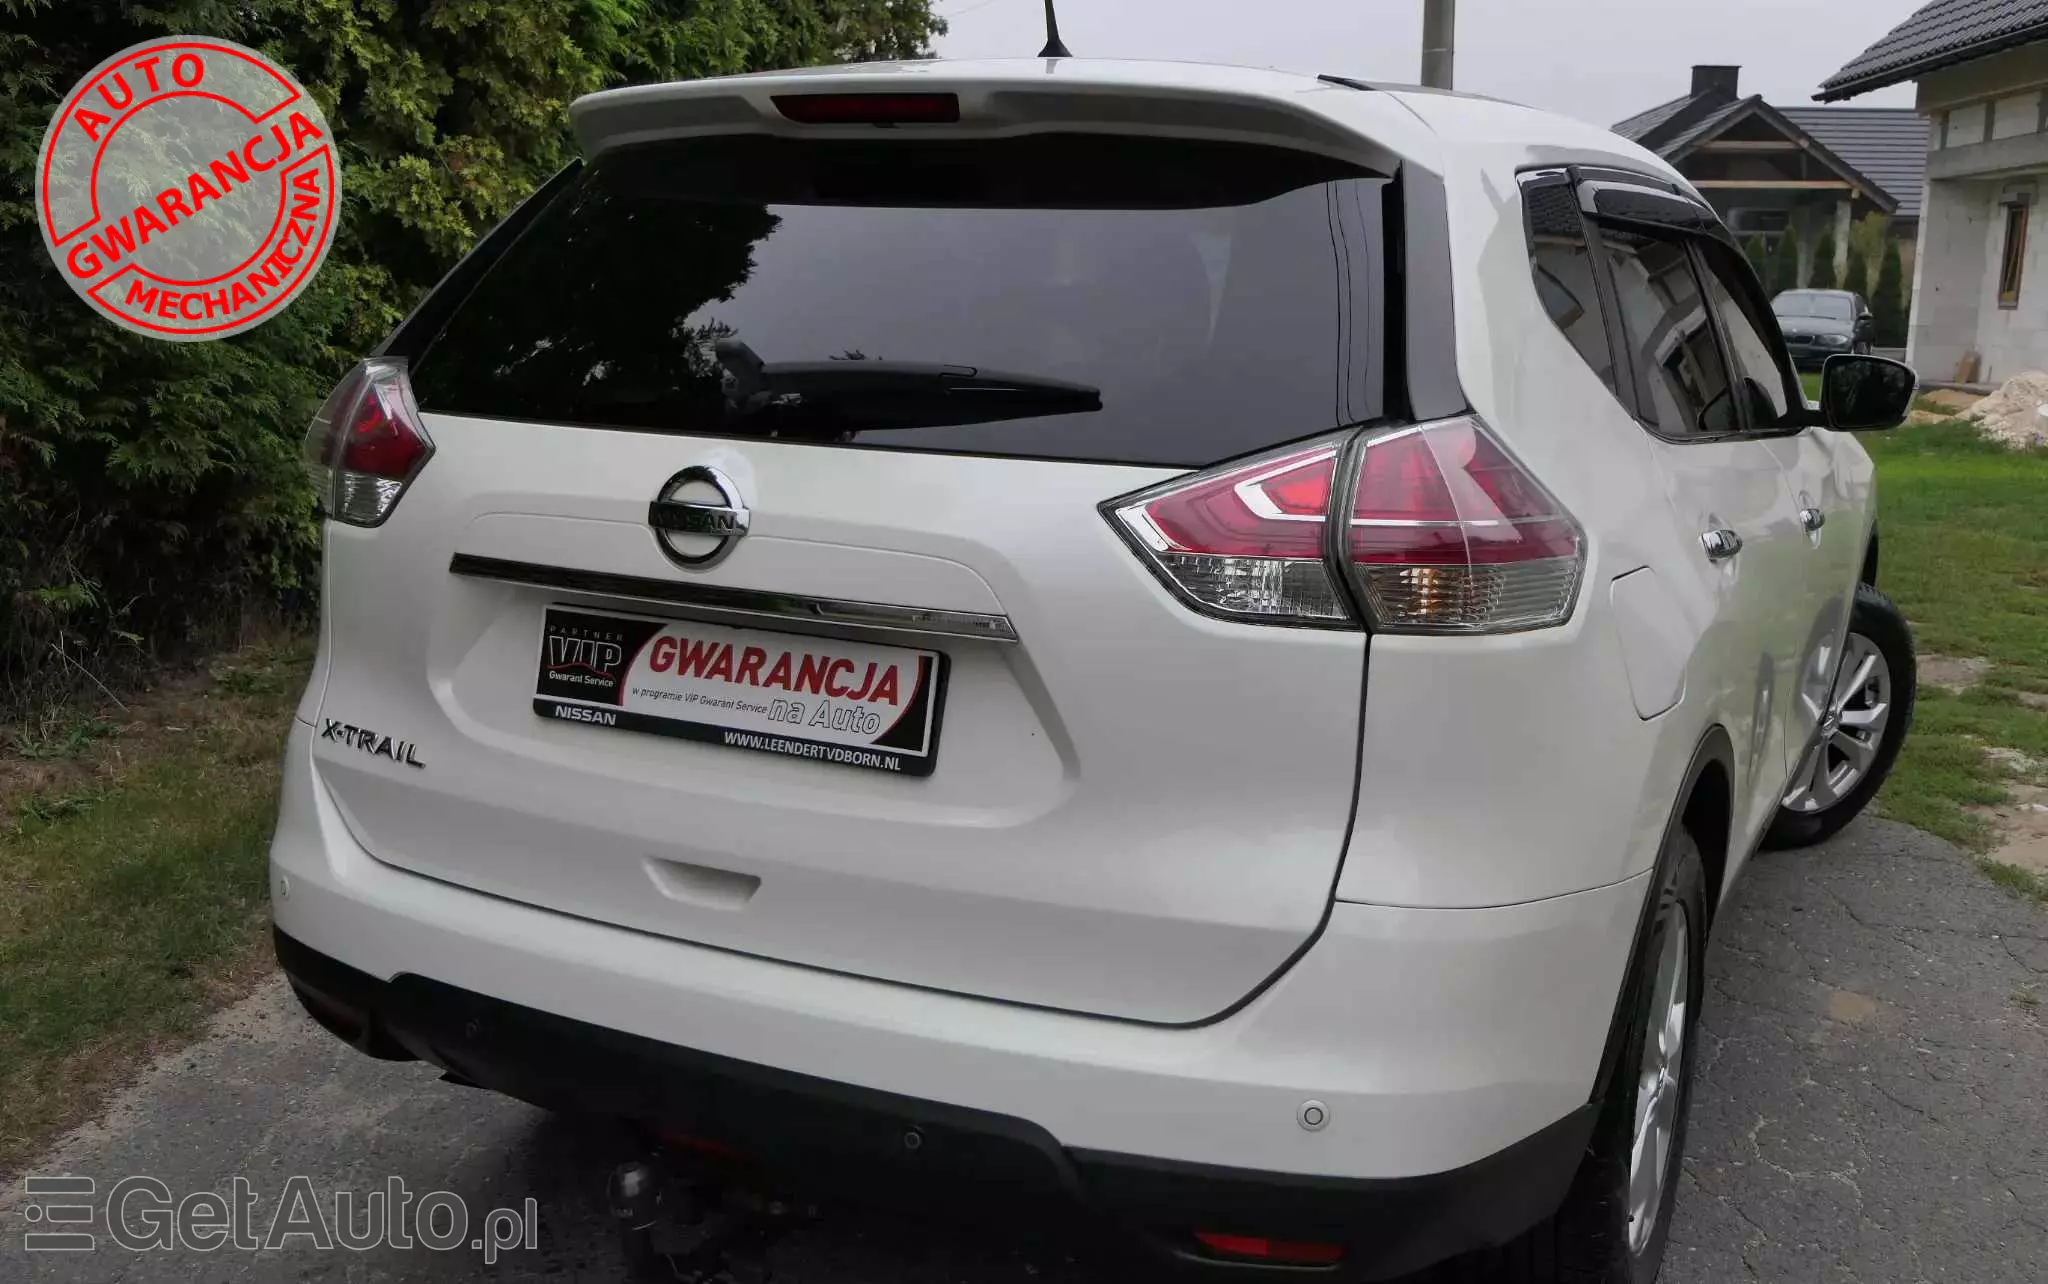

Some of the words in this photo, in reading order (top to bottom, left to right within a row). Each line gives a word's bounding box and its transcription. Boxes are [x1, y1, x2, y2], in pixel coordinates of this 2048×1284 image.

[549, 624, 624, 641] PARTNER
[548, 635, 623, 673] VIP
[649, 635, 899, 706] GWARANCJA
[548, 670, 583, 684] Gwarant
[583, 675, 614, 688] Service
[554, 704, 616, 726] NISSAN
[632, 687, 640, 695] w
[640, 687, 683, 702] programie
[684, 691, 699, 704] VIP
[700, 694, 735, 709] Gwarant
[736, 700, 768, 714] Service
[768, 697, 805, 725] na
[808, 699, 881, 735] Auto
[320, 717, 427, 769] X-TRAIL
[723, 731, 902, 772] WWW.LEENDERTVDBORN.NL
